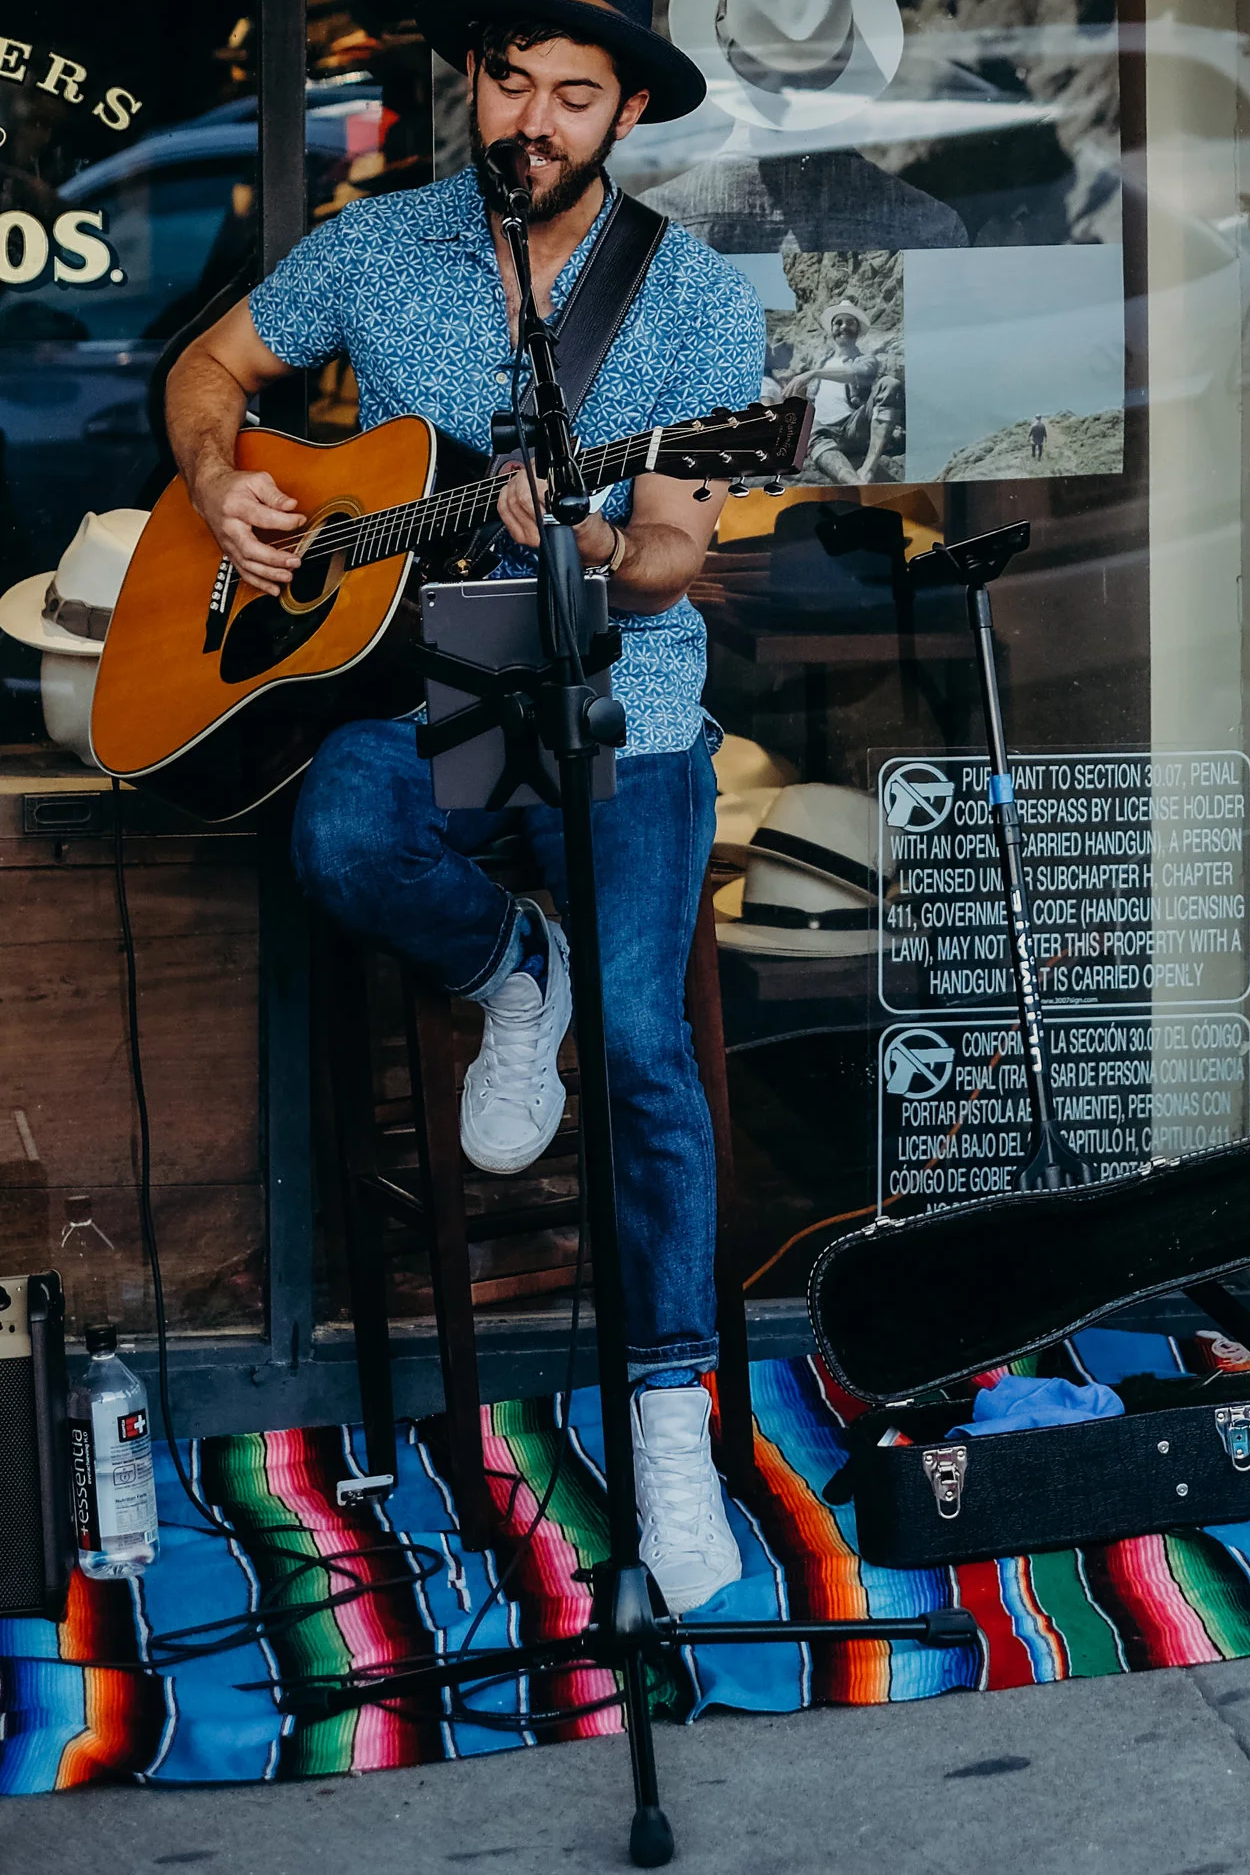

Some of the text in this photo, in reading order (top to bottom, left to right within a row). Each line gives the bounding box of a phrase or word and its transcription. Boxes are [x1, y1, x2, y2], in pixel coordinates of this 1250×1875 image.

[963, 765, 1046, 792] PURANT
[1049, 764, 1071, 790] TO
[1074, 762, 1141, 789] SECTION
[1190, 761, 1240, 786] PENAL
[1092, 795, 1112, 821] BY
[1116, 795, 1179, 822] LICENSE
[1183, 793, 1245, 819] HOLDER
[890, 834, 928, 861] WITH
[931, 833, 952, 860] AN
[954, 832, 1000, 860] OPEN
[1168, 828, 1179, 853] A
[1183, 827, 1242, 853] PERSON
[899, 868, 976, 895] LICENSED
[980, 865, 1034, 893] UNR
[1037, 863, 1139, 891] SUBCHAPTER
[1162, 861, 1234, 887] CHAPTER
[887, 893, 1245, 931] 411, GOVERNME CODE (HANDGUN LICENSING
[891, 928, 1243, 966] LAW), MAY NOT TER THIS PROPERTY WITH A
[930, 967, 1007, 995] HANDGUN
[1053, 966, 1069, 992] IS
[1072, 964, 1140, 992] CARRIED
[1142, 962, 1204, 989] OPENLY
[962, 1019, 1242, 1057] CONFORM LA SECCIÓN 30.07 DEL CÓDIGO
[955, 1065, 996, 1092] PENAL
[1079, 1062, 1097, 1086] DE
[1099, 1059, 1157, 1086] PERSONA
[1160, 1059, 1189, 1084] CON
[1190, 1056, 1244, 1083] LICENCIA
[902, 1099, 956, 1127] PORTAR
[959, 1097, 1014, 1125] PISTOLA
[1128, 1092, 1199, 1119] PERSONAS
[1202, 1090, 1231, 1116] CON
[898, 1133, 959, 1161] LICENCIA
[961, 1132, 996, 1158] BAJO
[999, 1131, 1024, 1157] DEL
[1125, 1127, 1140, 1156] H,
[889, 1163, 945, 1195] CÓDIGO
[948, 1167, 967, 1193] DE
[969, 1165, 1018, 1192] GOBIE
